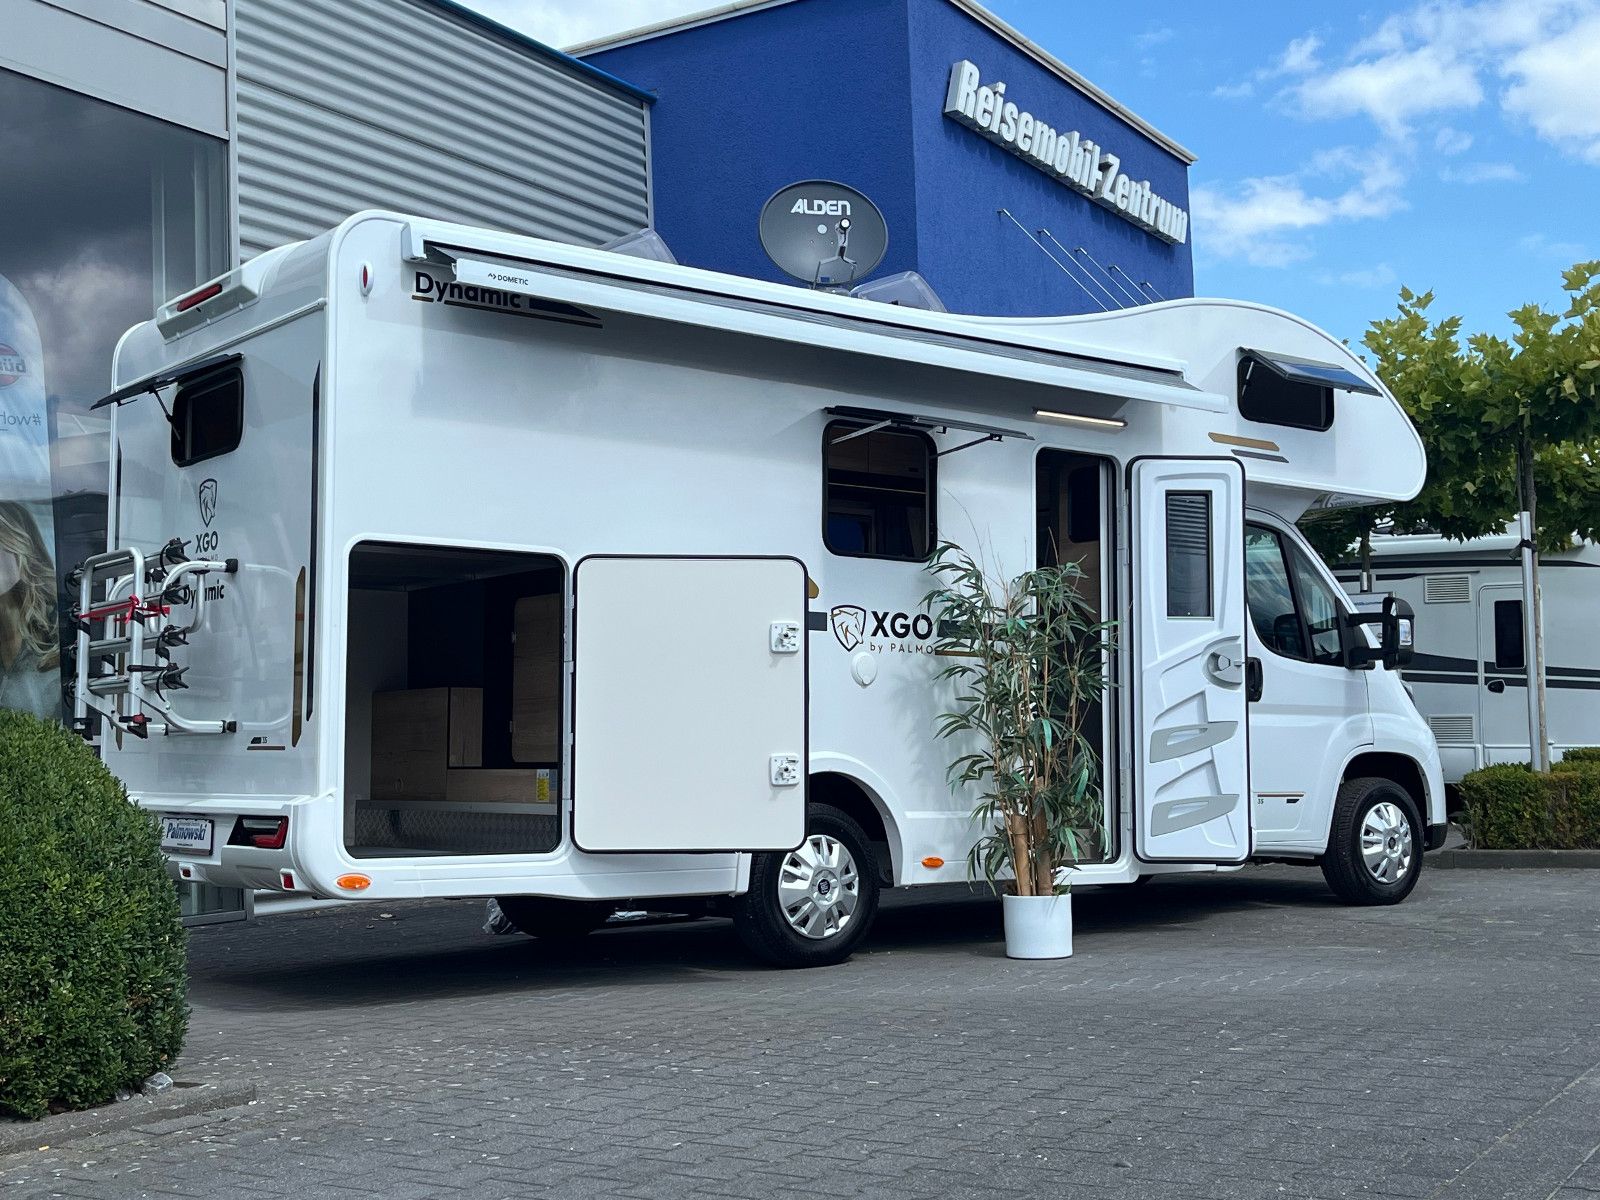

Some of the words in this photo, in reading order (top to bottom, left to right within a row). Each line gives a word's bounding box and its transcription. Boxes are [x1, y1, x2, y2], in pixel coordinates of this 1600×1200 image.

[790, 199, 851, 215] ALDEN
[415, 271, 522, 309] Dynamic
[497, 274, 529, 286] DOMETIC
[195, 530, 219, 554] XGO
[183, 579, 225, 609] Dymic
[870, 610, 934, 641] XGO
[870, 642, 883, 654] by
[166, 822, 208, 841] Palmowski
